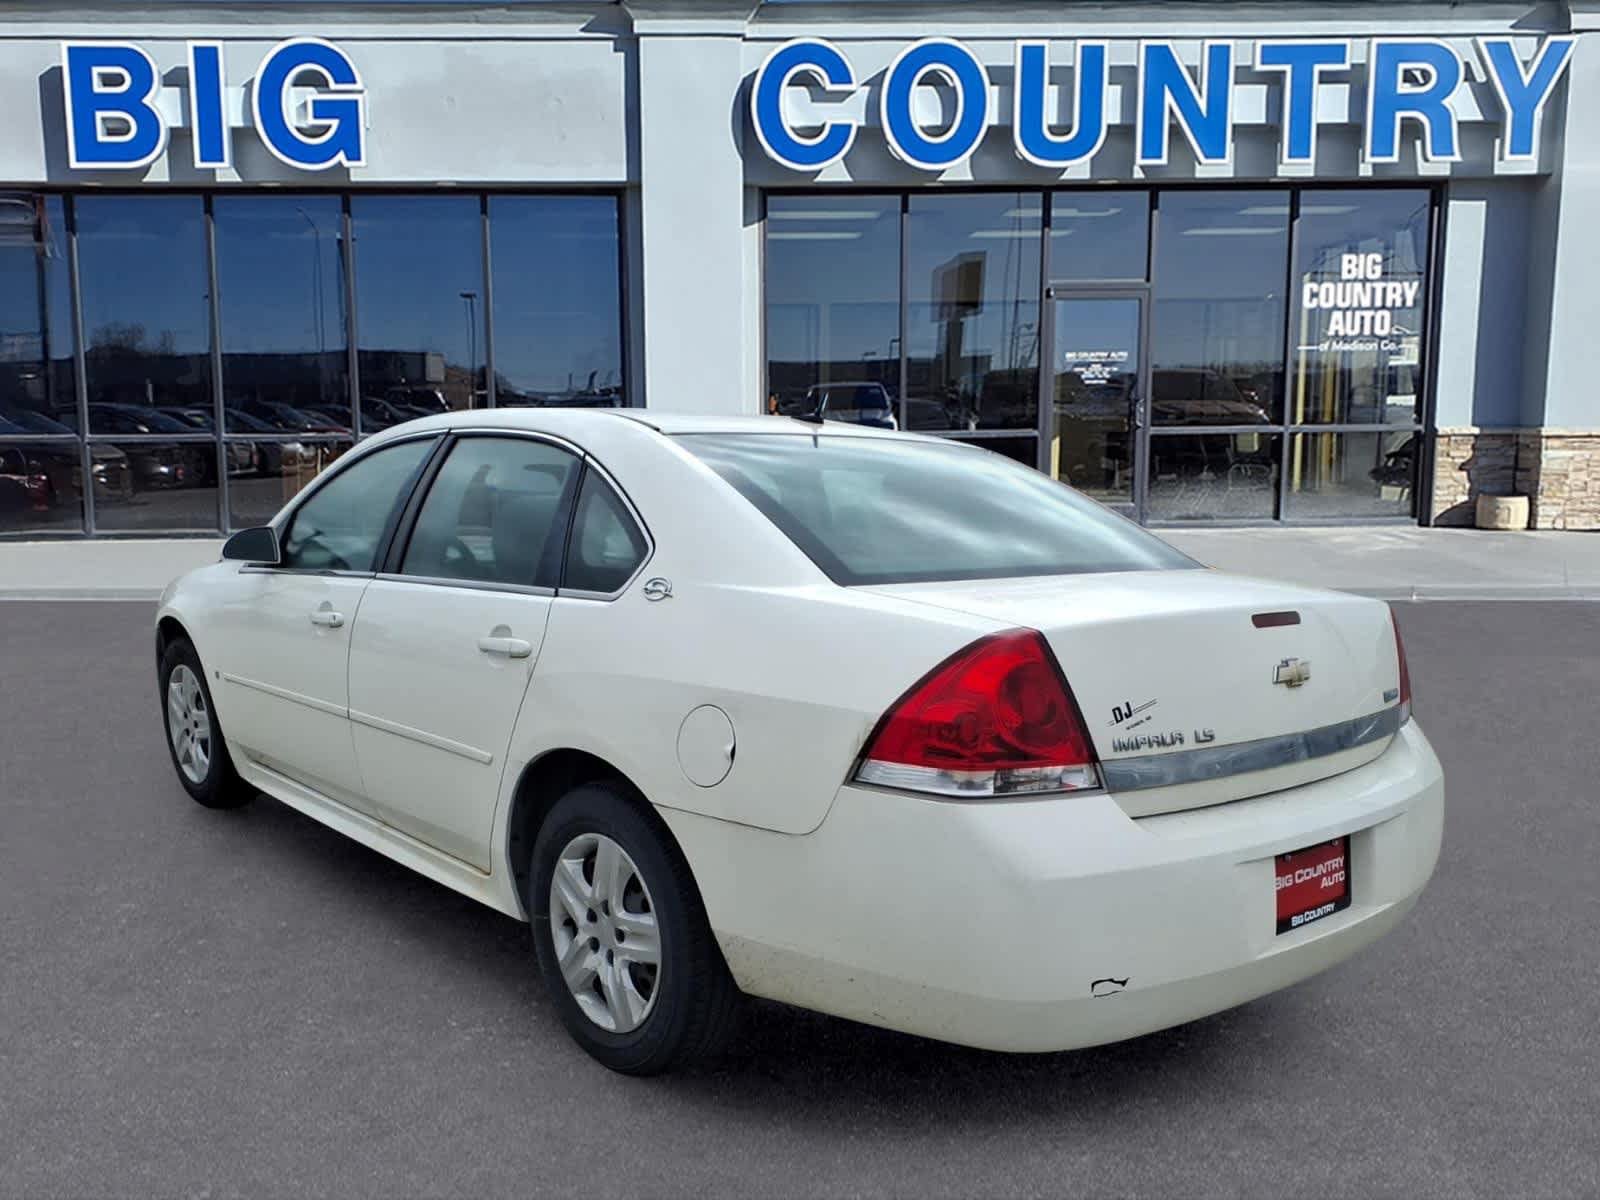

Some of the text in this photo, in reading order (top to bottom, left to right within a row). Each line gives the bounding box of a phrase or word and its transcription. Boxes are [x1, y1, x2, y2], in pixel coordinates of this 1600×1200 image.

[61, 37, 1576, 171] BIG COUNTRY
[1341, 253, 1383, 280] BIG
[1302, 281, 1420, 308] COUNTRY
[1327, 309, 1392, 337] AUTO
[1111, 701, 1133, 724] DJ
[1112, 729, 1216, 752] IMPALA LS
[1274, 856, 1345, 890] BIG COUNTRY
[1320, 871, 1345, 889] AUTO
[1291, 902, 1336, 926] BIG COUNTRY
